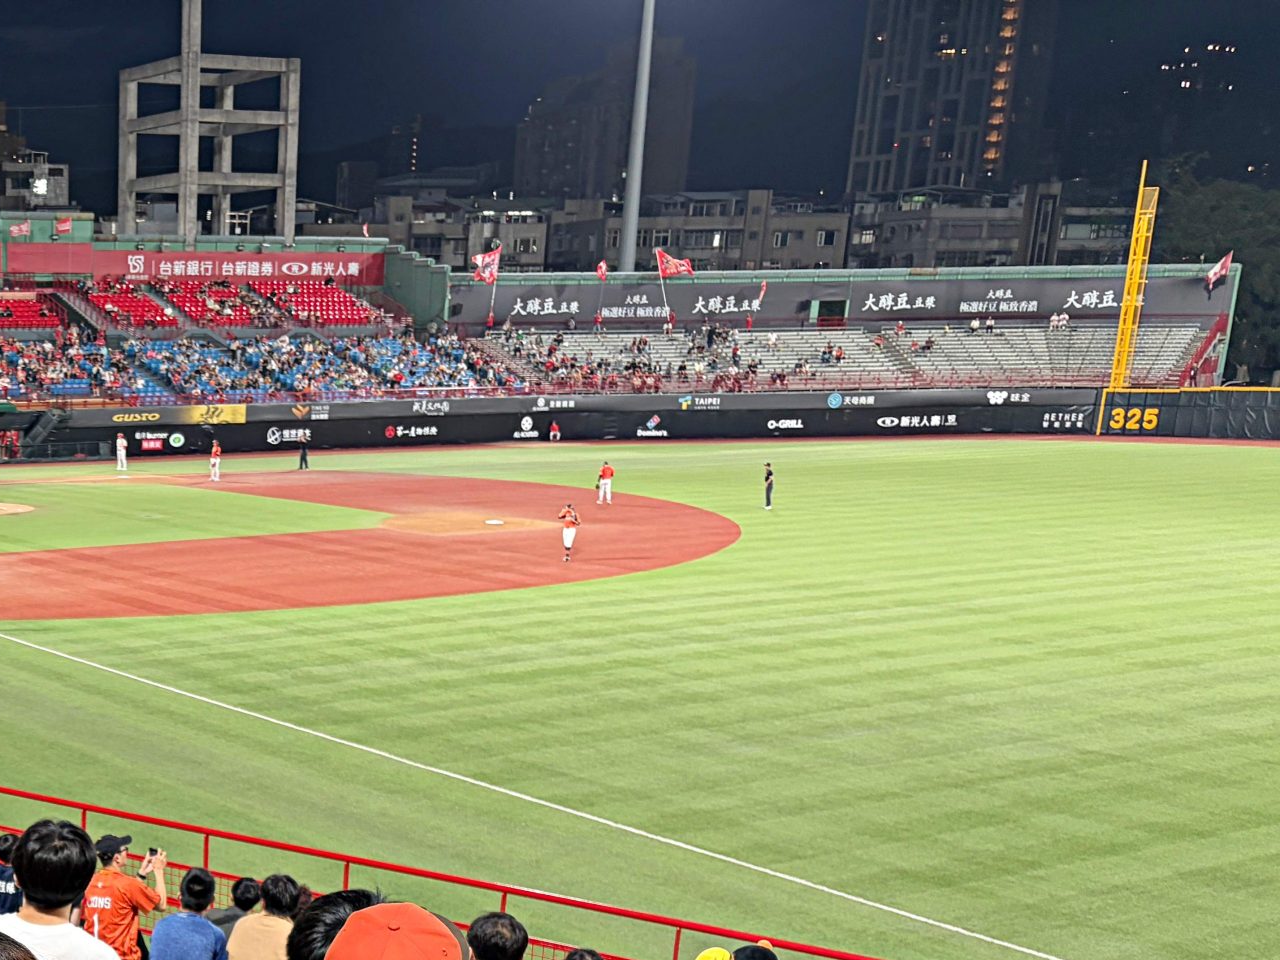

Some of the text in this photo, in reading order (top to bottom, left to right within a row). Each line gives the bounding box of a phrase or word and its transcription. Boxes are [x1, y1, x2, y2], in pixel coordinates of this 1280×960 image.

[159, 261, 213, 276] 台新銀行
[221, 261, 273, 276] 台新證券
[511, 297, 558, 316] 大醇豆
[692, 295, 739, 314] 大醇豆
[864, 293, 912, 312] 大醇豆
[1063, 289, 1118, 309] 大醇豆
[694, 397, 720, 405] TAIPEI
[112, 413, 161, 423] GUSTO
[767, 418, 804, 429] O-GRILL
[900, 415, 942, 428] 新光人壽
[1109, 408, 1160, 430] 325
[636, 429, 668, 437] Domino's
